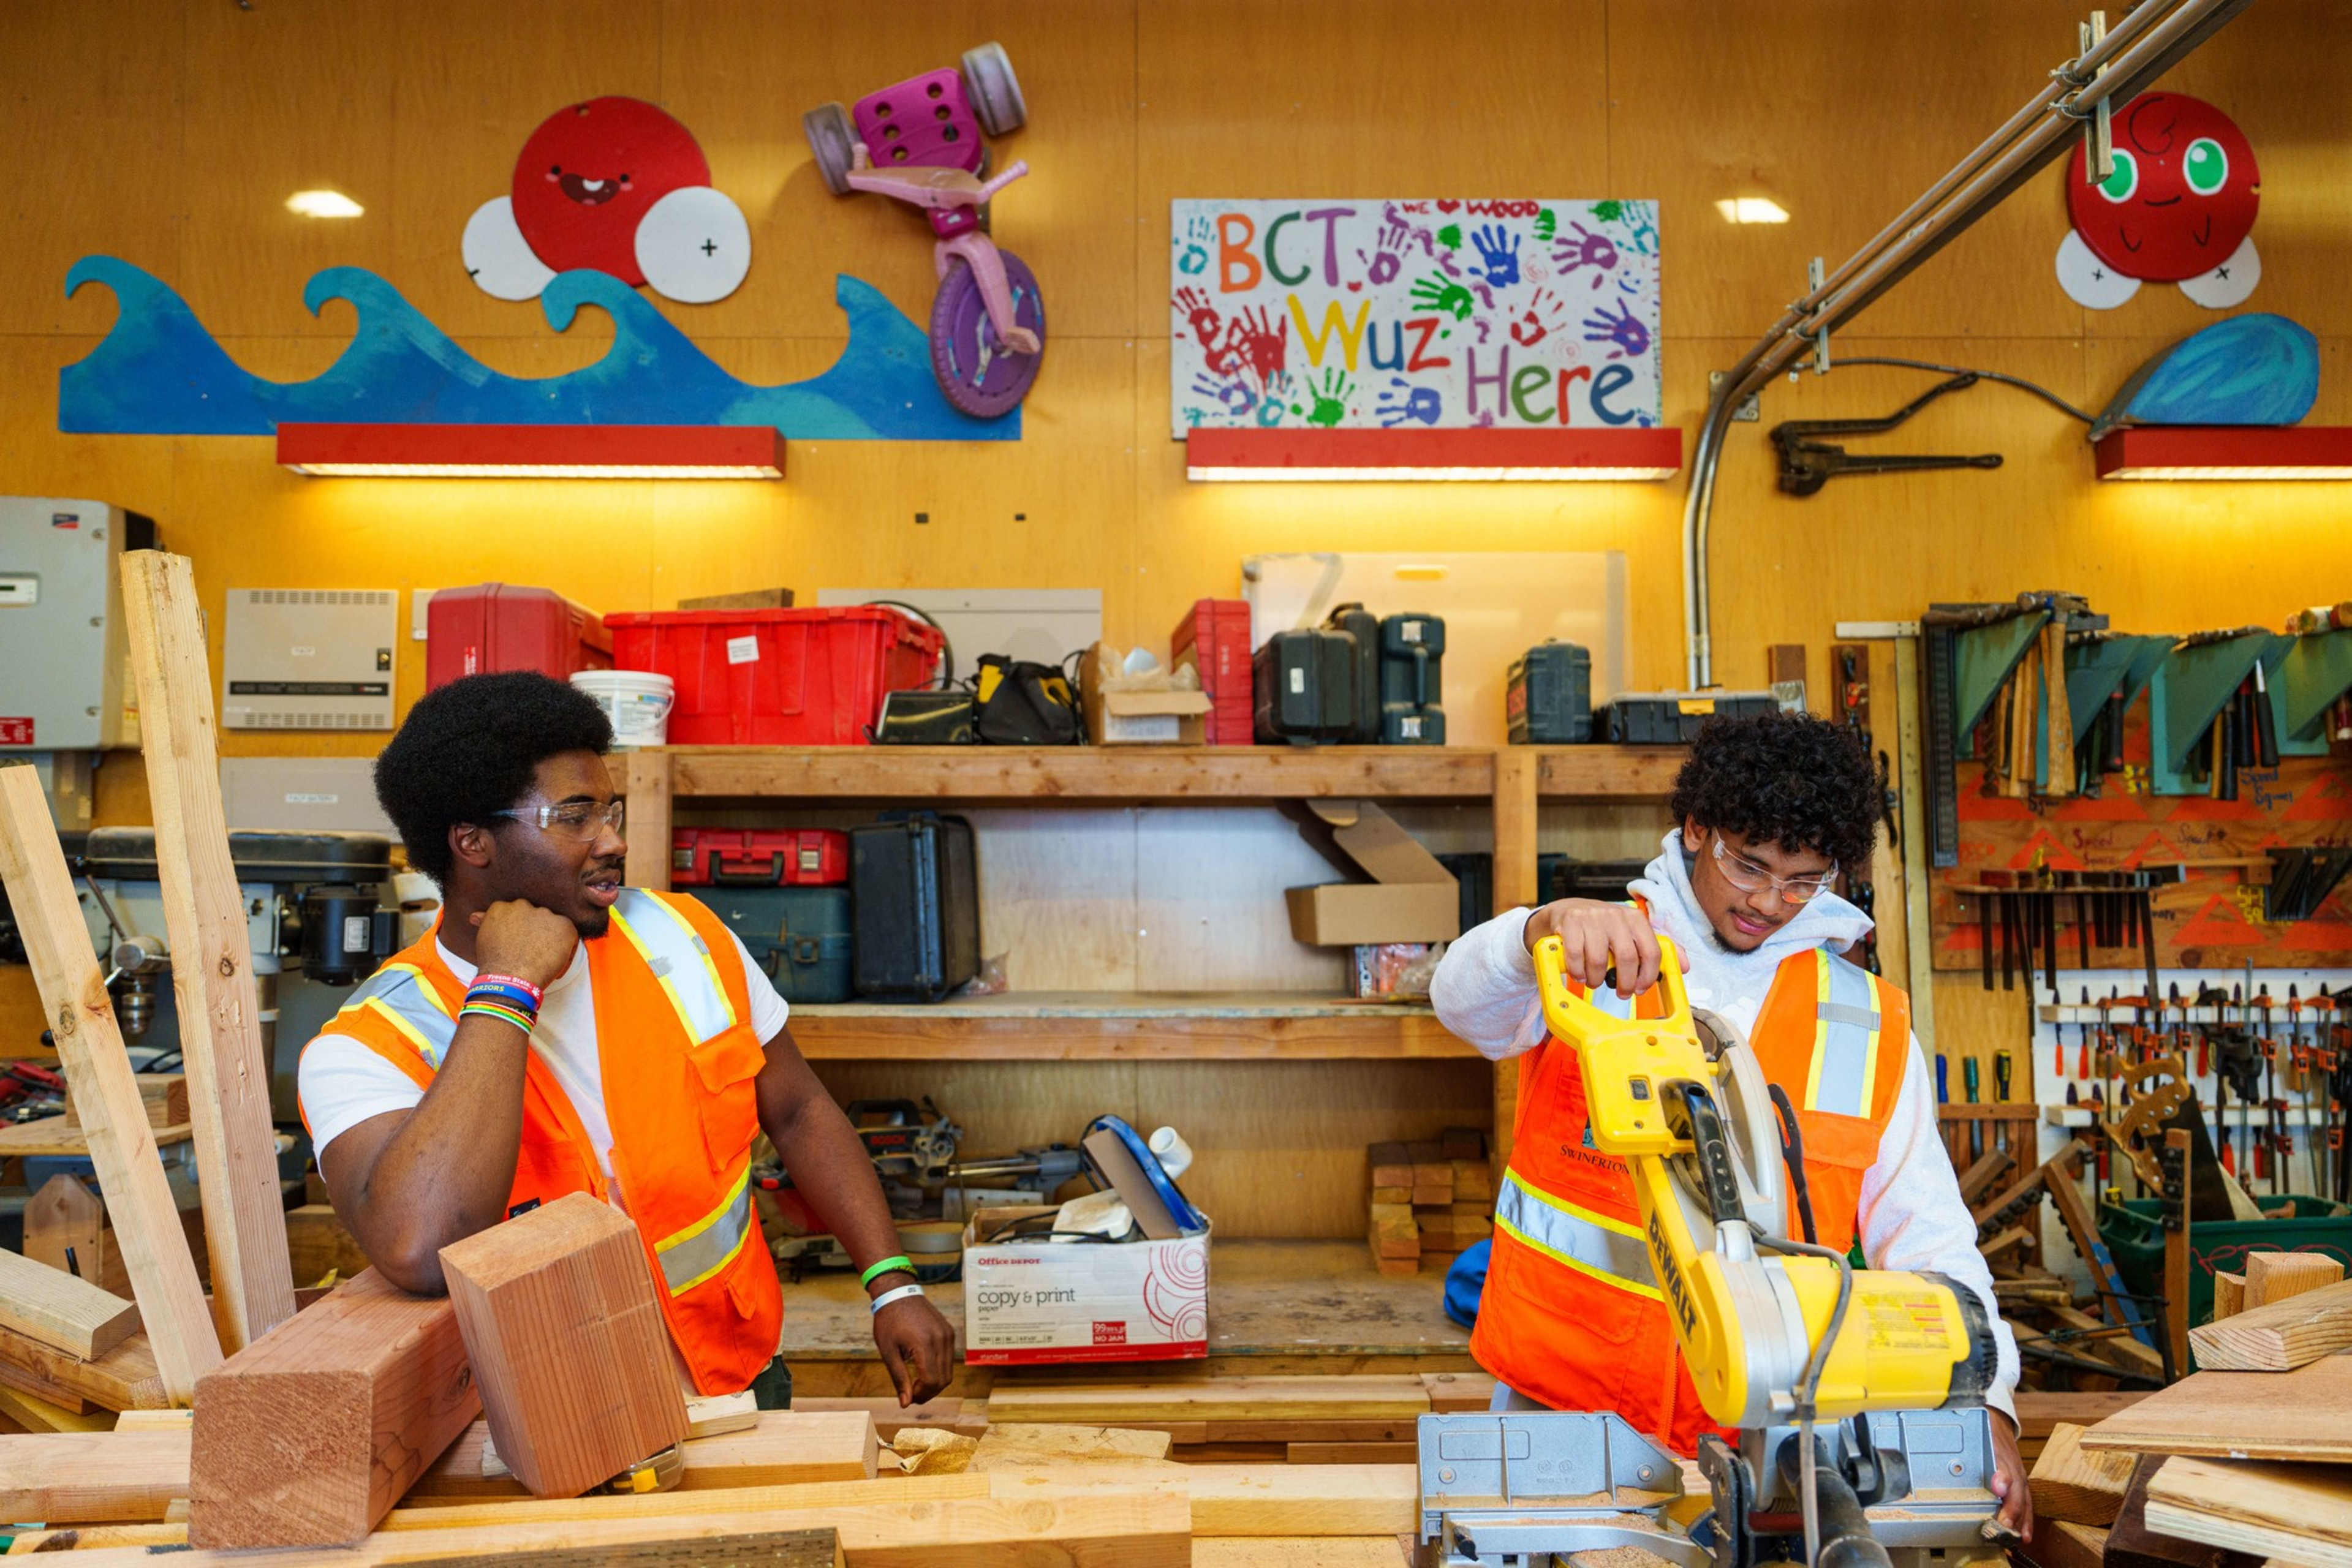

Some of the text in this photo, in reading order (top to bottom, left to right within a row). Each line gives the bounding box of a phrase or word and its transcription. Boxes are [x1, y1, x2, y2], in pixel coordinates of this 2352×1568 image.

[1402, 199, 1540, 219] WE WOOD
[1216, 207, 1356, 294] BCT
[1287, 293, 1451, 374] Wuz
[1467, 343, 1635, 425] Here
[871, 1135, 906, 1145] BOSCH
[978, 1257, 1009, 1266] Office
[1649, 1207, 1696, 1339] DEWALT
[978, 1287, 1076, 1308] copy & print
